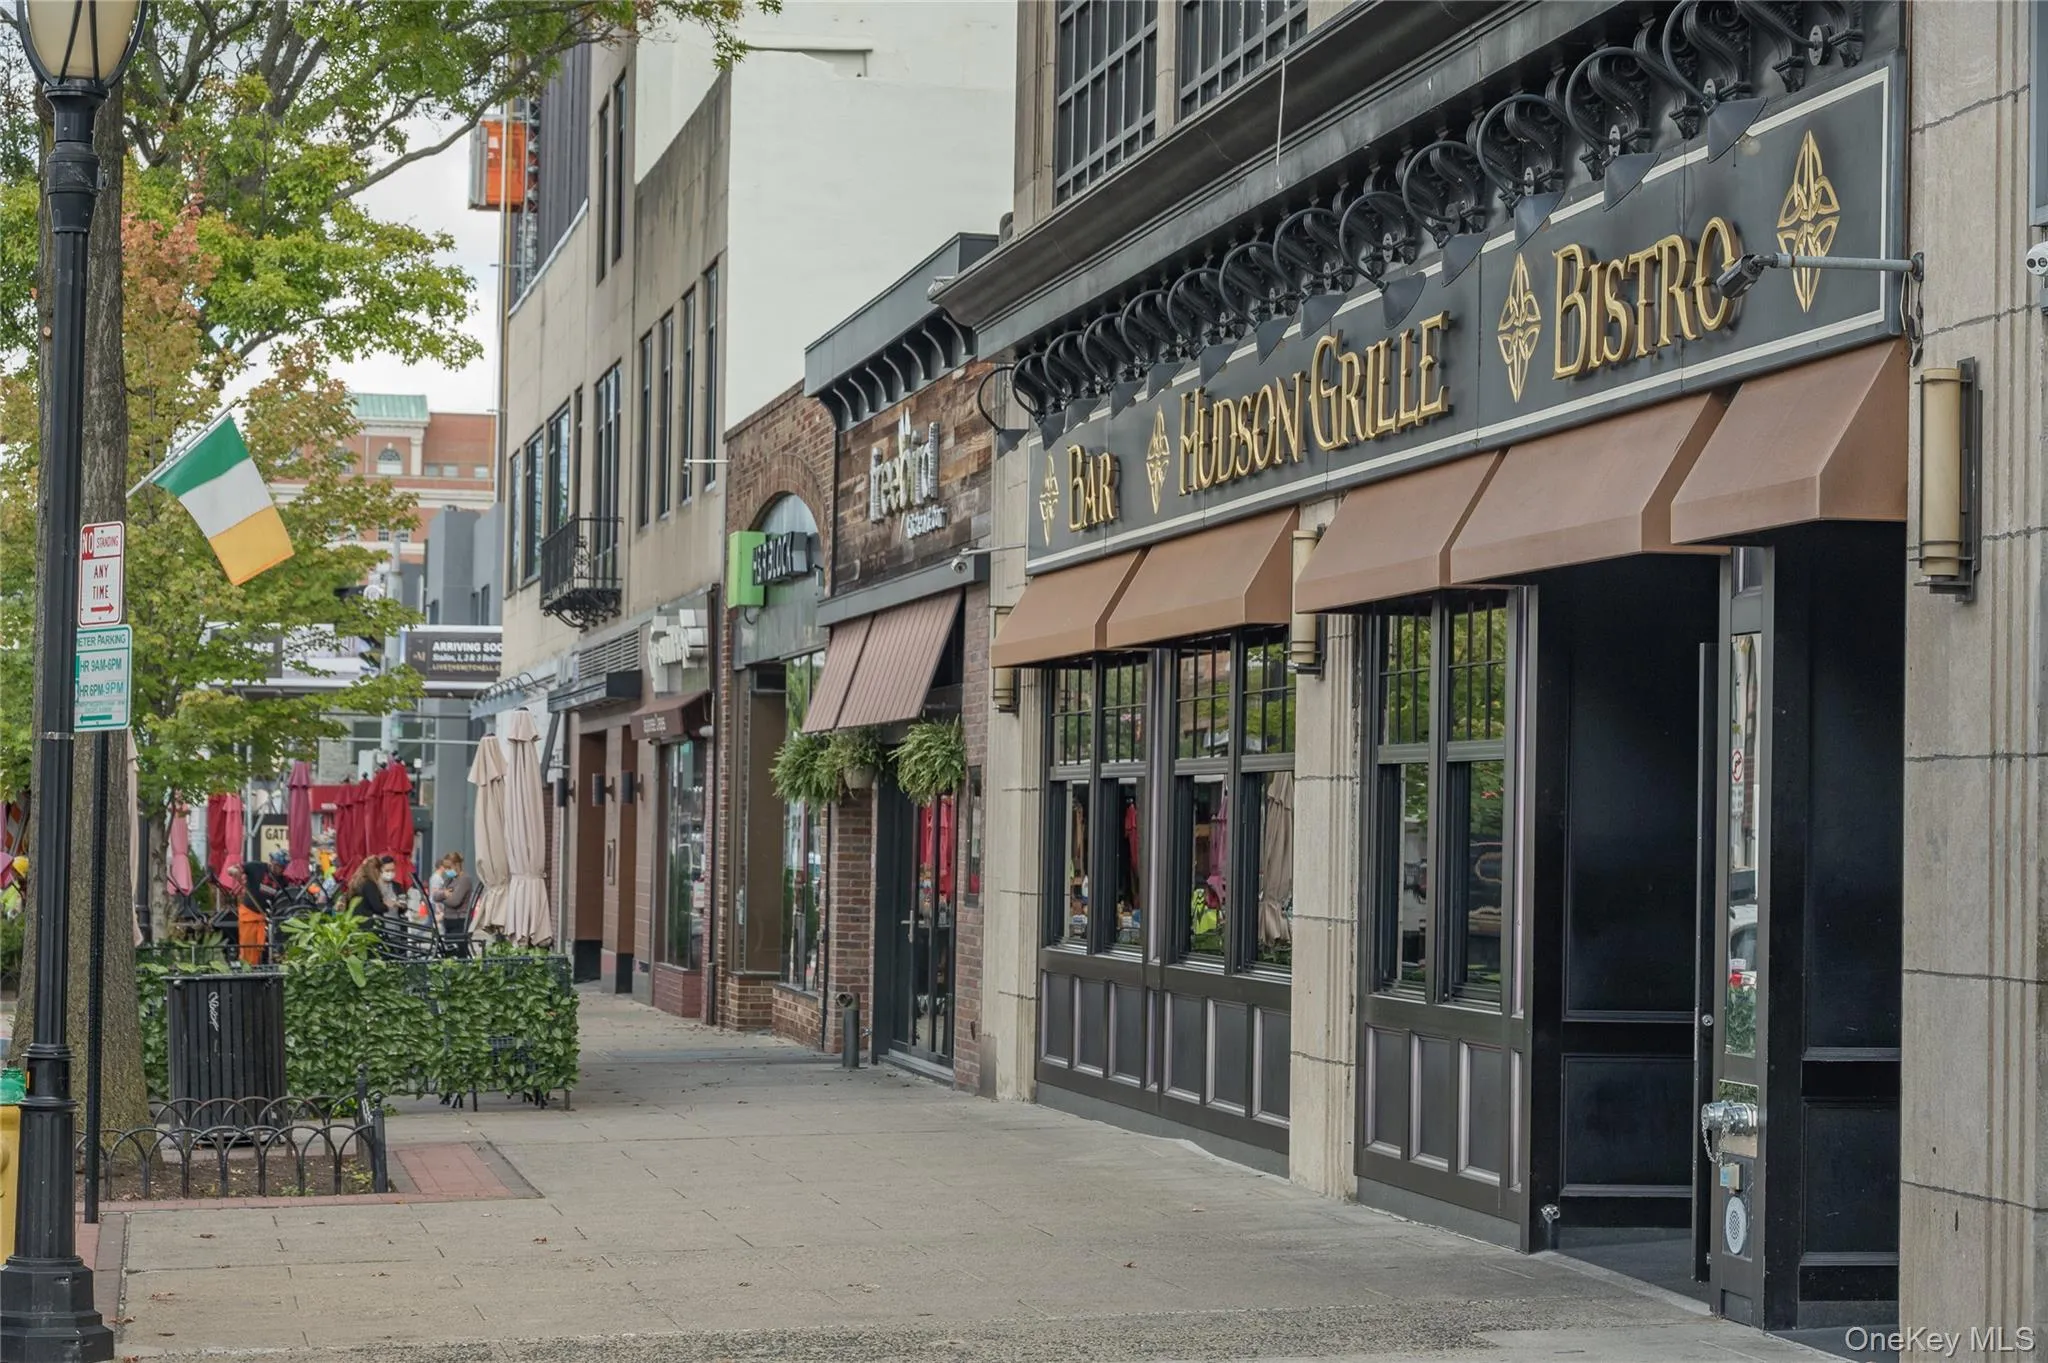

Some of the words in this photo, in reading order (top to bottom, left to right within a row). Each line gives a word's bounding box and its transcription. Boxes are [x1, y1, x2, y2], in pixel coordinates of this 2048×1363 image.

[1067, 444, 1121, 532] BAR
[1178, 370, 1308, 497] HUDSON
[1308, 310, 1451, 451] GRILLE
[1552, 216, 1742, 380] BISTRO
[82, 531, 94, 555] NO
[96, 535, 119, 549] STANDING
[767, 533, 793, 580] BLOCK
[93, 563, 109, 579] ANY
[92, 584, 109, 600] TIME
[77, 636, 96, 648] ETER
[97, 633, 126, 647] PARKING
[432, 641, 481, 652] ARRIVING
[80, 660, 90, 673] HR
[91, 657, 122, 673] 9AM-6PM
[79, 684, 89, 698] HR
